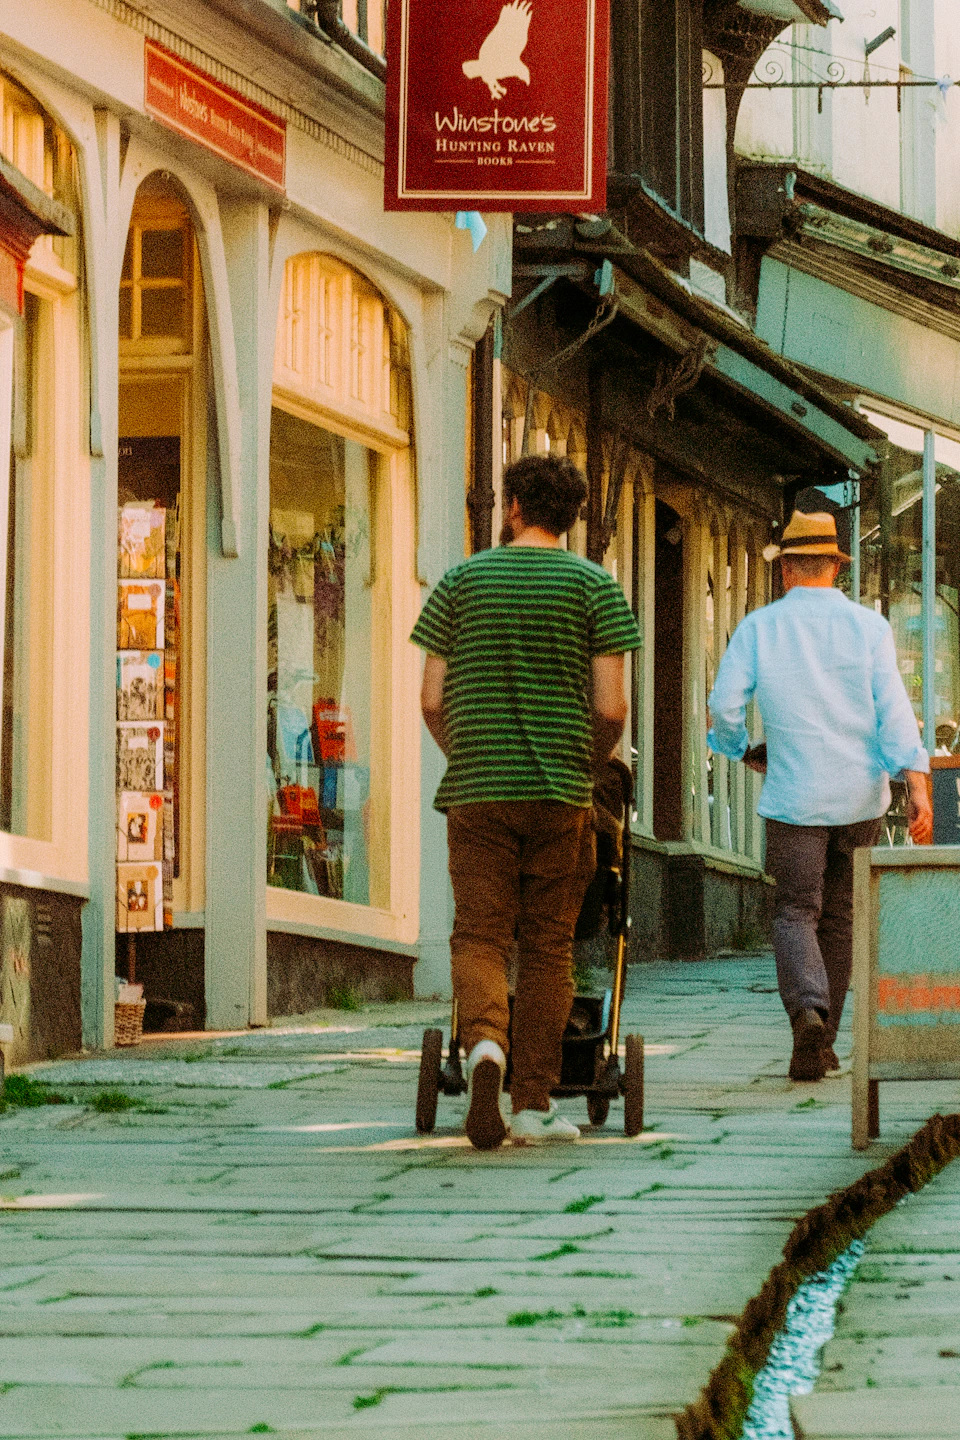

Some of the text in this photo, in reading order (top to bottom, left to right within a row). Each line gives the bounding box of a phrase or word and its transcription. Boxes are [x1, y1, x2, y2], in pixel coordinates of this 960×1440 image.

[435, 106, 557, 134] Winstone's
[436, 139, 555, 152] HUNTING RAVEN
[477, 157, 513, 166] BOOKS
